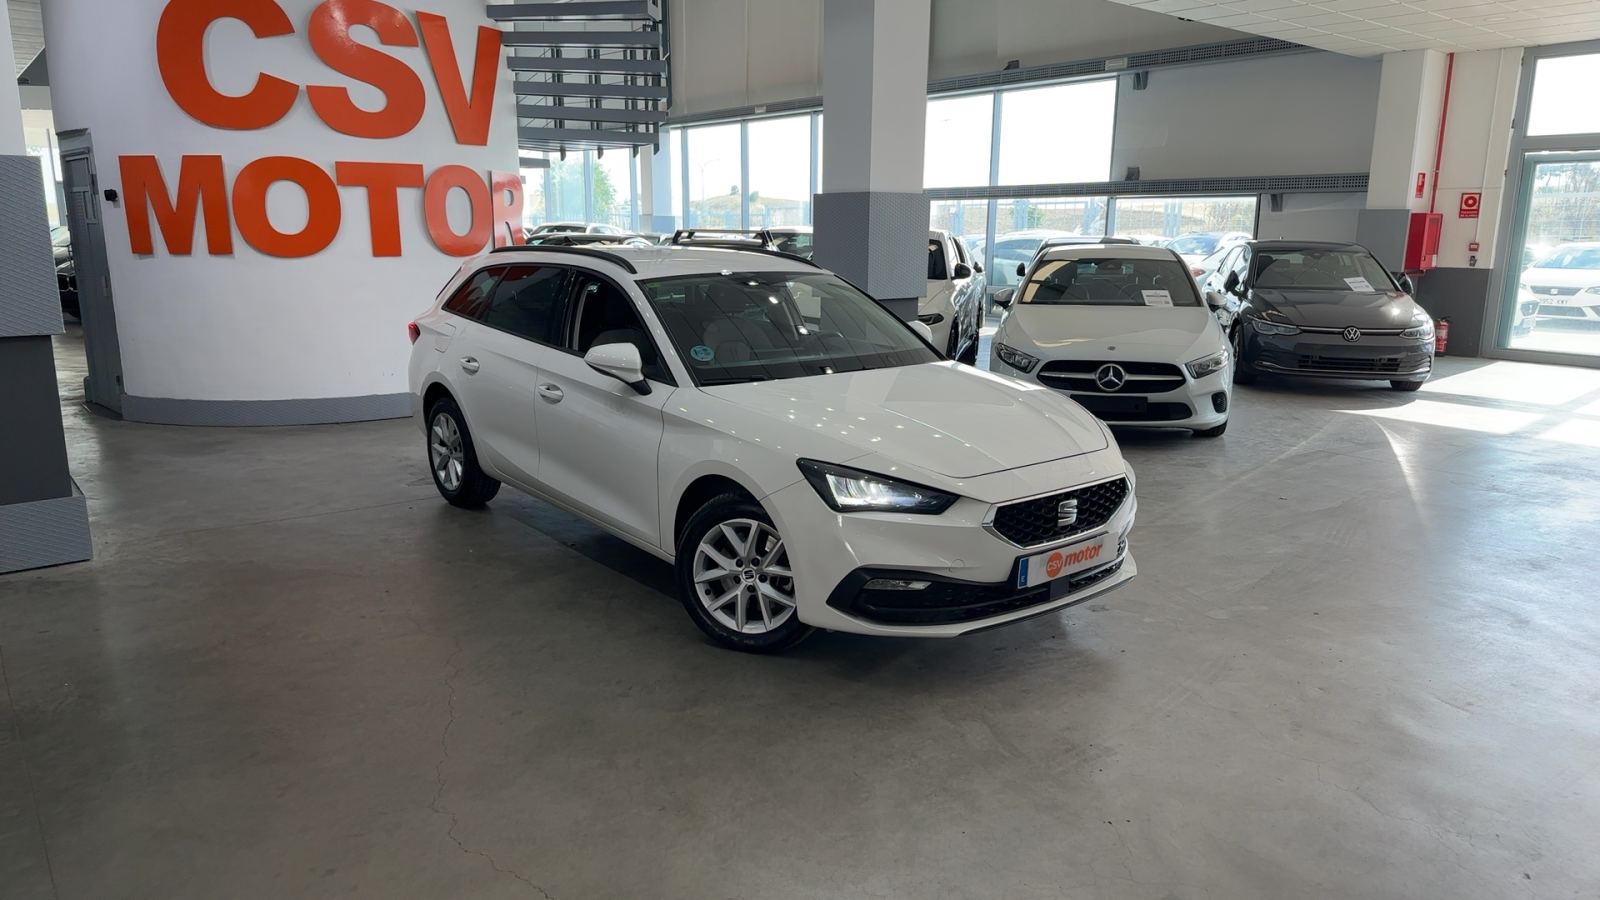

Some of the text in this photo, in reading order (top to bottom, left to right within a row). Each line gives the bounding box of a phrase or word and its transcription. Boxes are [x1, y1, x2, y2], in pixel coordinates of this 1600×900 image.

[156, 0, 503, 146] CSV
[118, 154, 525, 258] MOTOR
[1064, 543, 1103, 567] motor
